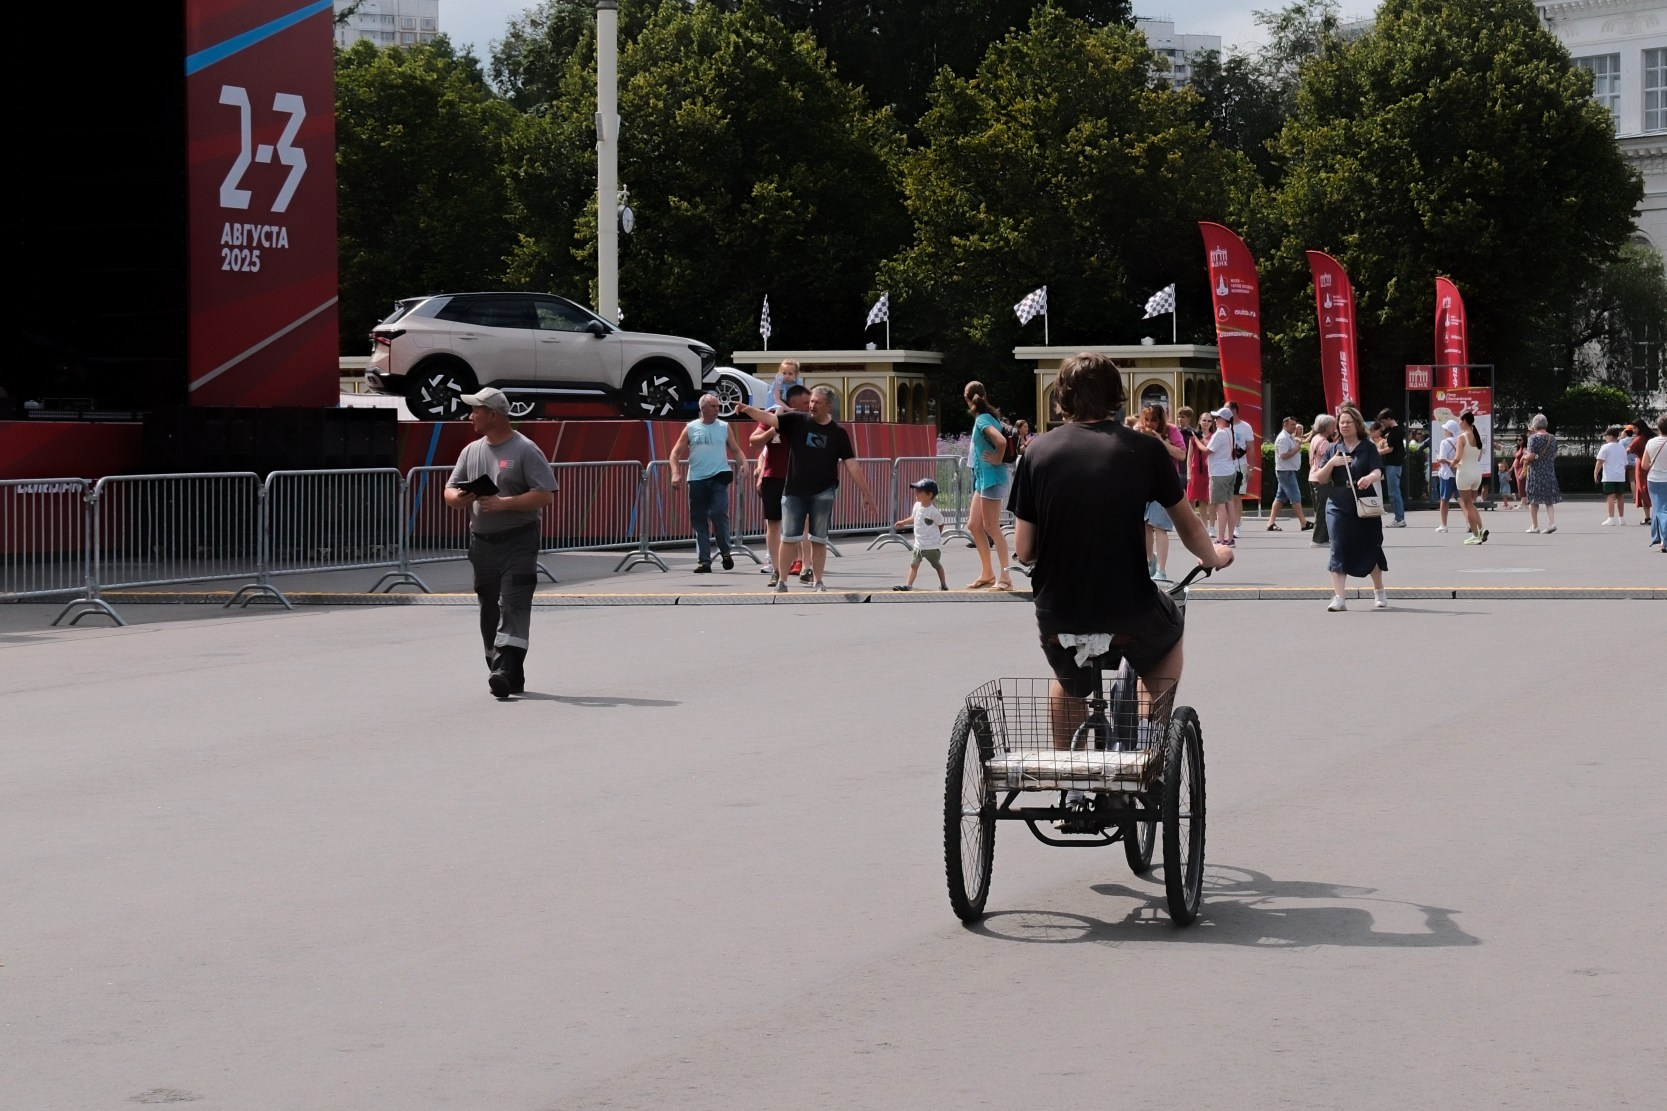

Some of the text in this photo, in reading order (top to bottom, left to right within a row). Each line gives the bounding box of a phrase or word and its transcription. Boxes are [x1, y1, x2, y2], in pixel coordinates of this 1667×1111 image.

[219, 85, 307, 213] 2-3
[221, 222, 289, 249] АВГУСТА
[221, 248, 261, 273] 2025
